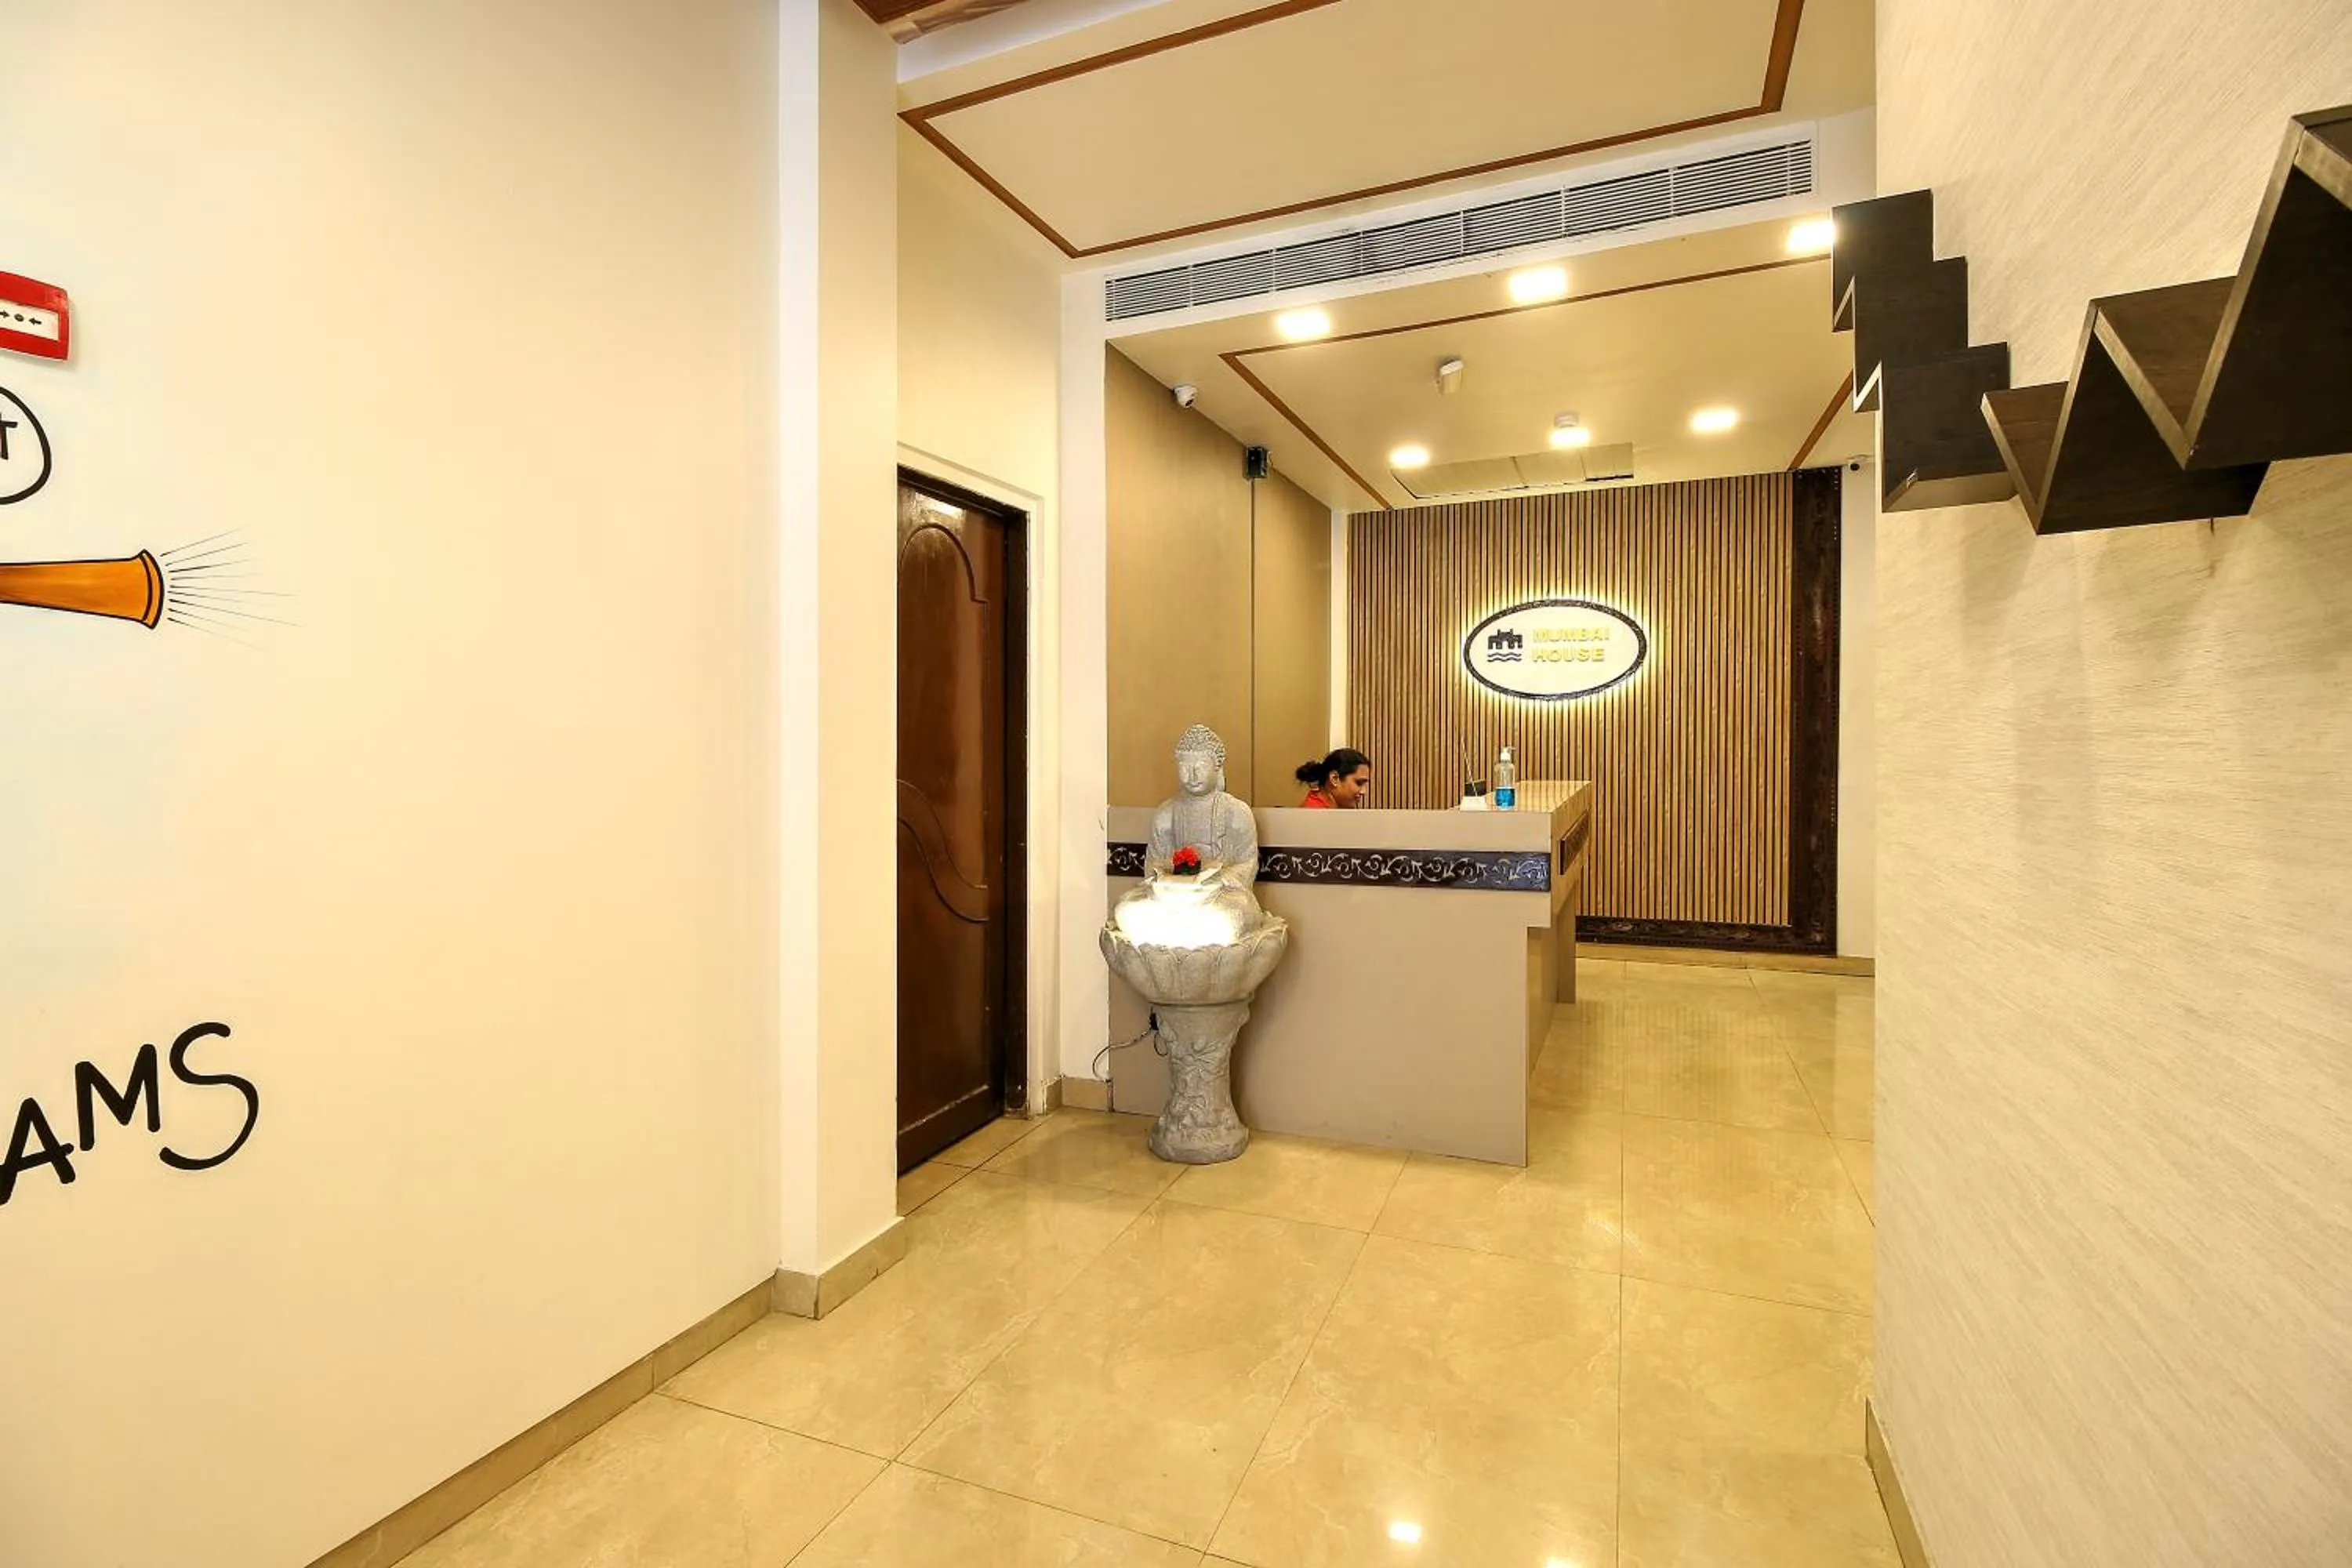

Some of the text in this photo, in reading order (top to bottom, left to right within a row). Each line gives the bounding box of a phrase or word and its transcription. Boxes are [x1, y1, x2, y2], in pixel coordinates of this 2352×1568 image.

[1533, 628, 1610, 642] MUMBAI
[1533, 648, 1605, 662] HOUSE
[0, 1022, 260, 1206] AMS
